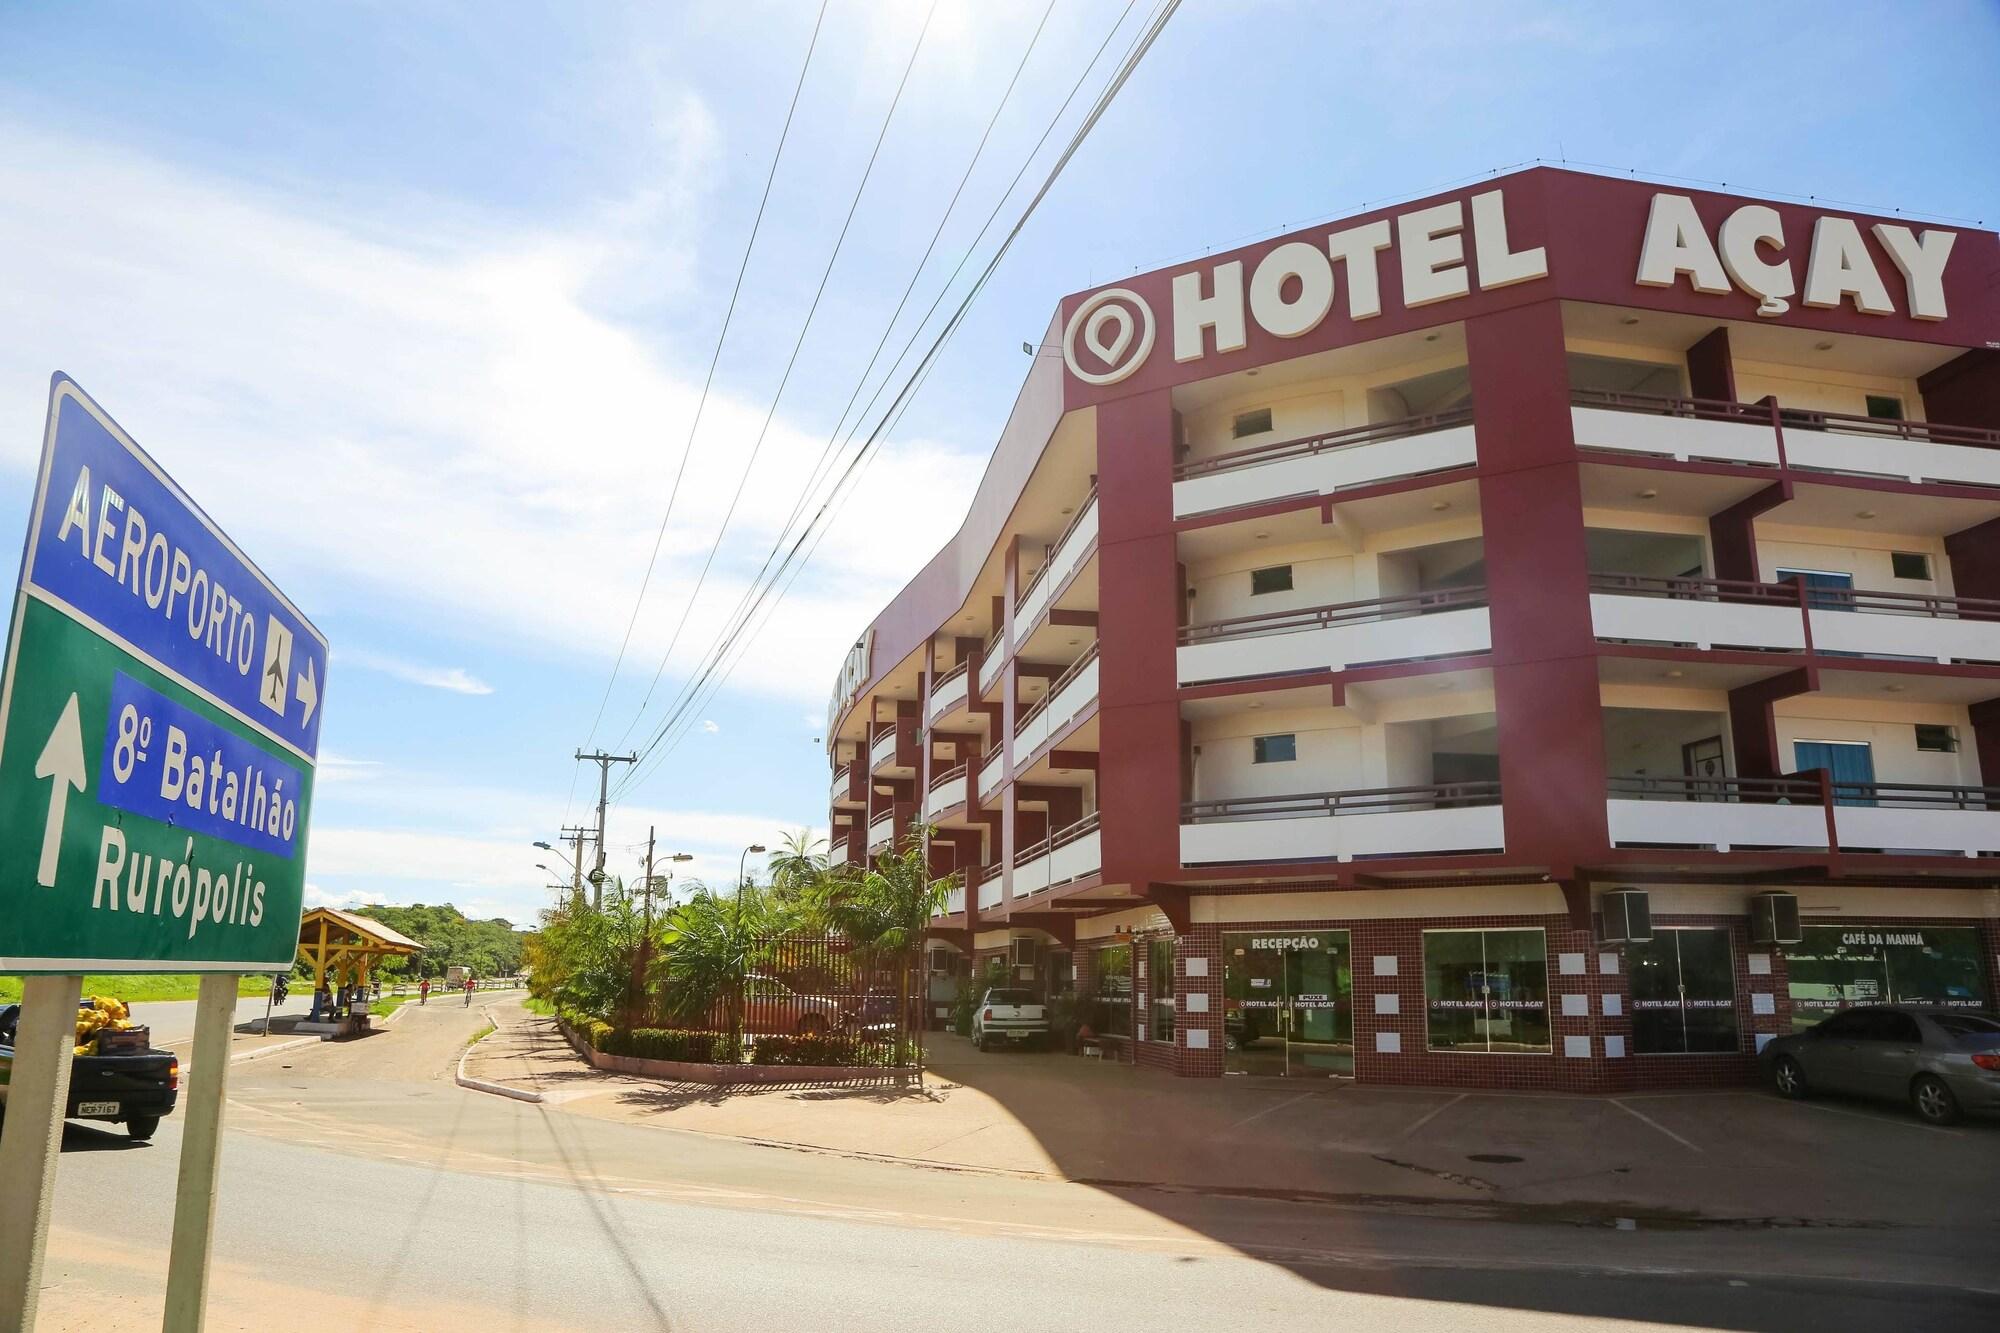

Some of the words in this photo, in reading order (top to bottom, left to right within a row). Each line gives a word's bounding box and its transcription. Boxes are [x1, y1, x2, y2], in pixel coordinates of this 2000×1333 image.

[1172, 189, 1549, 364] HOTEL
[1636, 192, 1958, 321] AÇAY
[57, 464, 256, 677] AEROPORTO
[92, 824, 267, 940] Rurópolis
[1842, 930, 1866, 945] CAFÉ
[1868, 933, 1883, 945] DA
[1252, 936, 1319, 952] RECEPÇÃO
